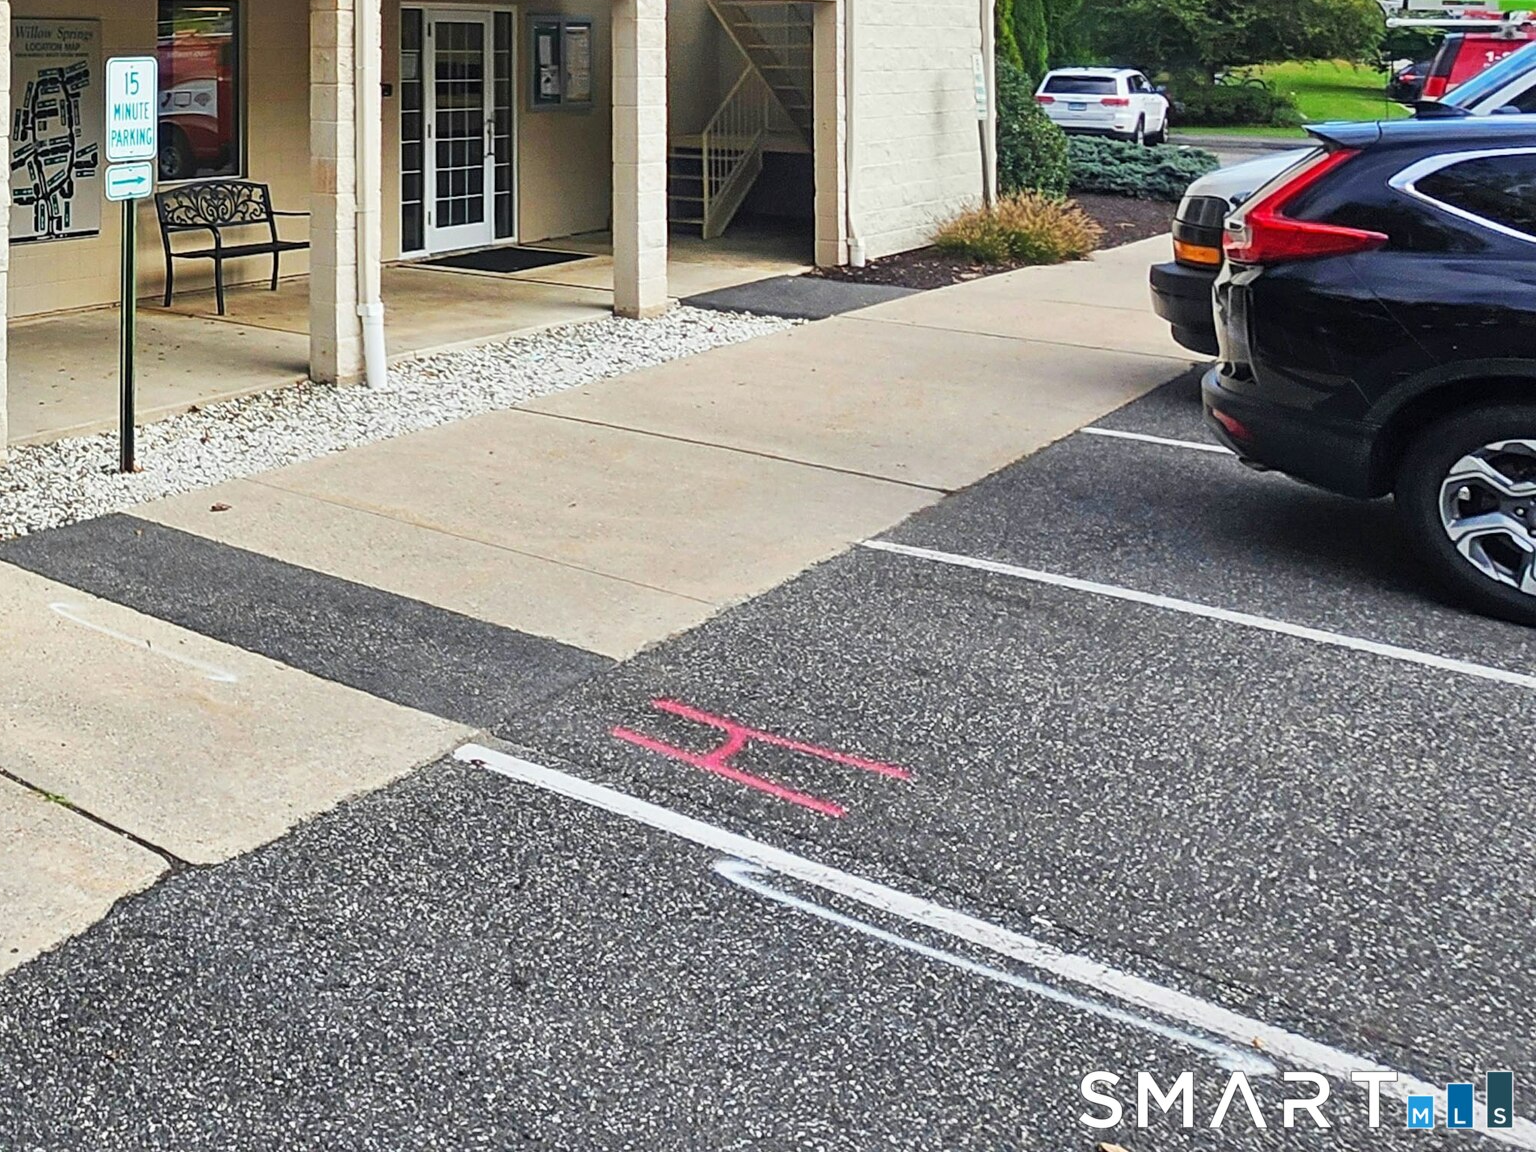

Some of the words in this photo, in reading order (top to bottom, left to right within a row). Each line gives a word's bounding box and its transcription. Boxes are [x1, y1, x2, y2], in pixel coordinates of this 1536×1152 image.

[15, 25, 52, 39] Willow
[57, 26, 94, 42] Springs
[25, 42, 63, 52] LOCATION
[64, 41, 81, 51] MAP
[124, 72, 140, 96] 15
[113, 102, 150, 122] MINUTE
[111, 127, 153, 148] PARKING
